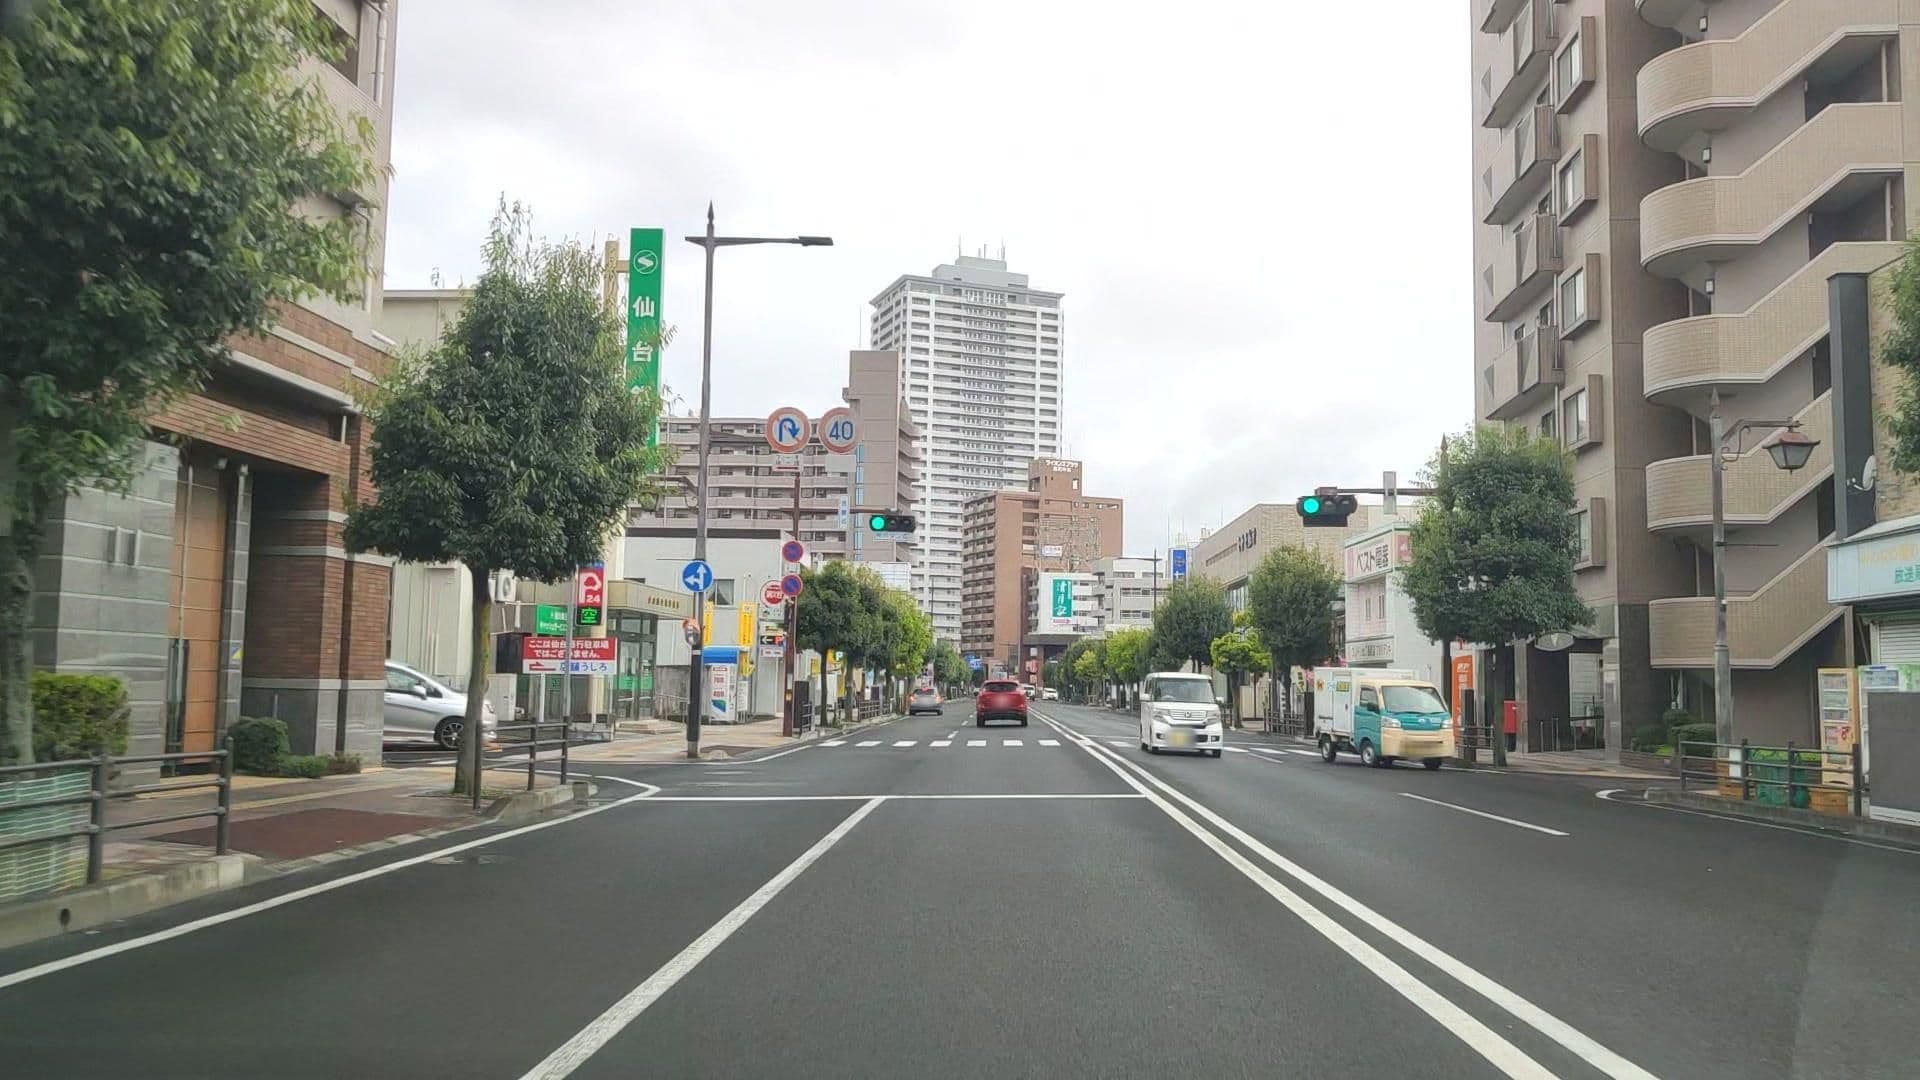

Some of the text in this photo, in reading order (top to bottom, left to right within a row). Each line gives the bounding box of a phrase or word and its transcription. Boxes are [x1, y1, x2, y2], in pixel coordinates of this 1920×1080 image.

[829, 421, 853, 440] 40
[586, 594, 600, 603] 24
[581, 607, 597, 623] 空
